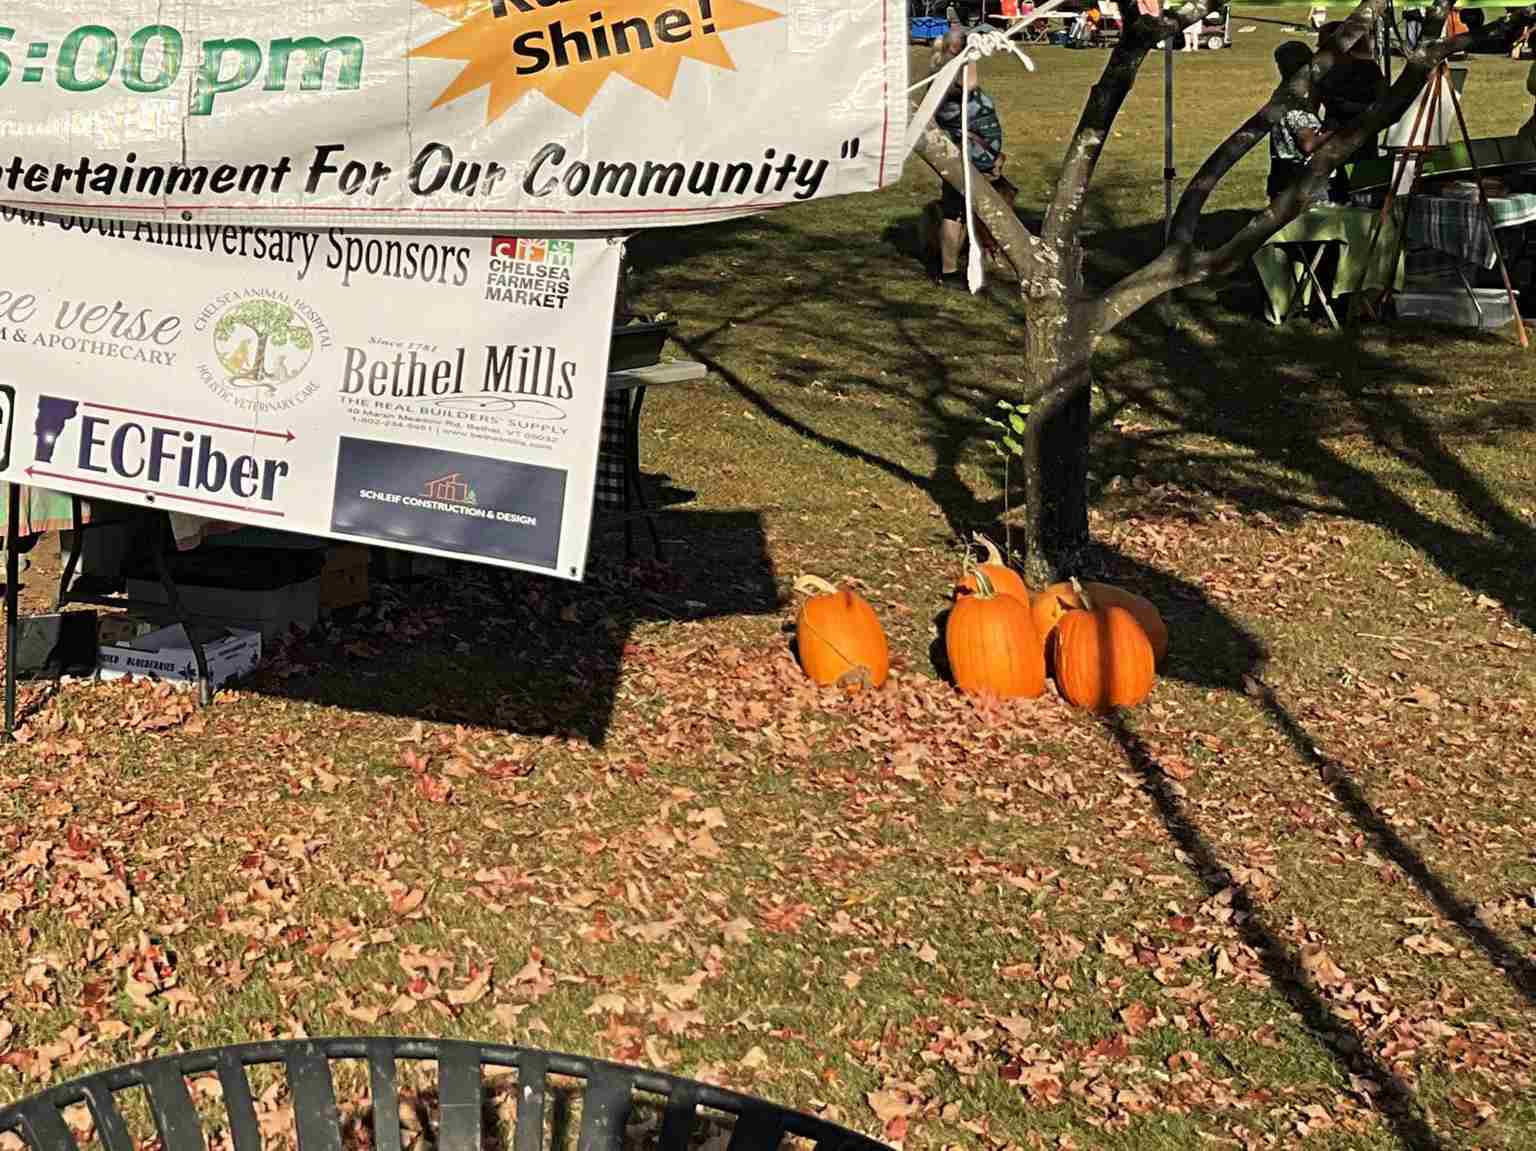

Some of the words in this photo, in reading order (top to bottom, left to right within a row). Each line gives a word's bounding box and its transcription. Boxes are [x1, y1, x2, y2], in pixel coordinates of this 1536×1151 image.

[305, 144, 391, 195] For
[408, 143, 507, 197] Our
[326, 227, 470, 287] Sponsors
[489, 259, 570, 280] CHELSEA
[485, 287, 568, 309] MARKET
[488, 273, 569, 294] FARMERS
[55, 298, 182, 346] verse
[14, 329, 26, 343] &
[33, 333, 177, 366] APOTHECARY
[339, 346, 465, 397] Bethel
[480, 345, 576, 400] Mills
[340, 397, 371, 407] THE
[374, 401, 415, 412] REAL
[509, 419, 568, 435] SUPPLY
[78, 415, 289, 501] ECFiber
[359, 489, 401, 503] SCHLEIF
[402, 497, 486, 519] CONSTRUCTION
[486, 509, 494, 519] &
[496, 511, 537, 526] DESIGN
